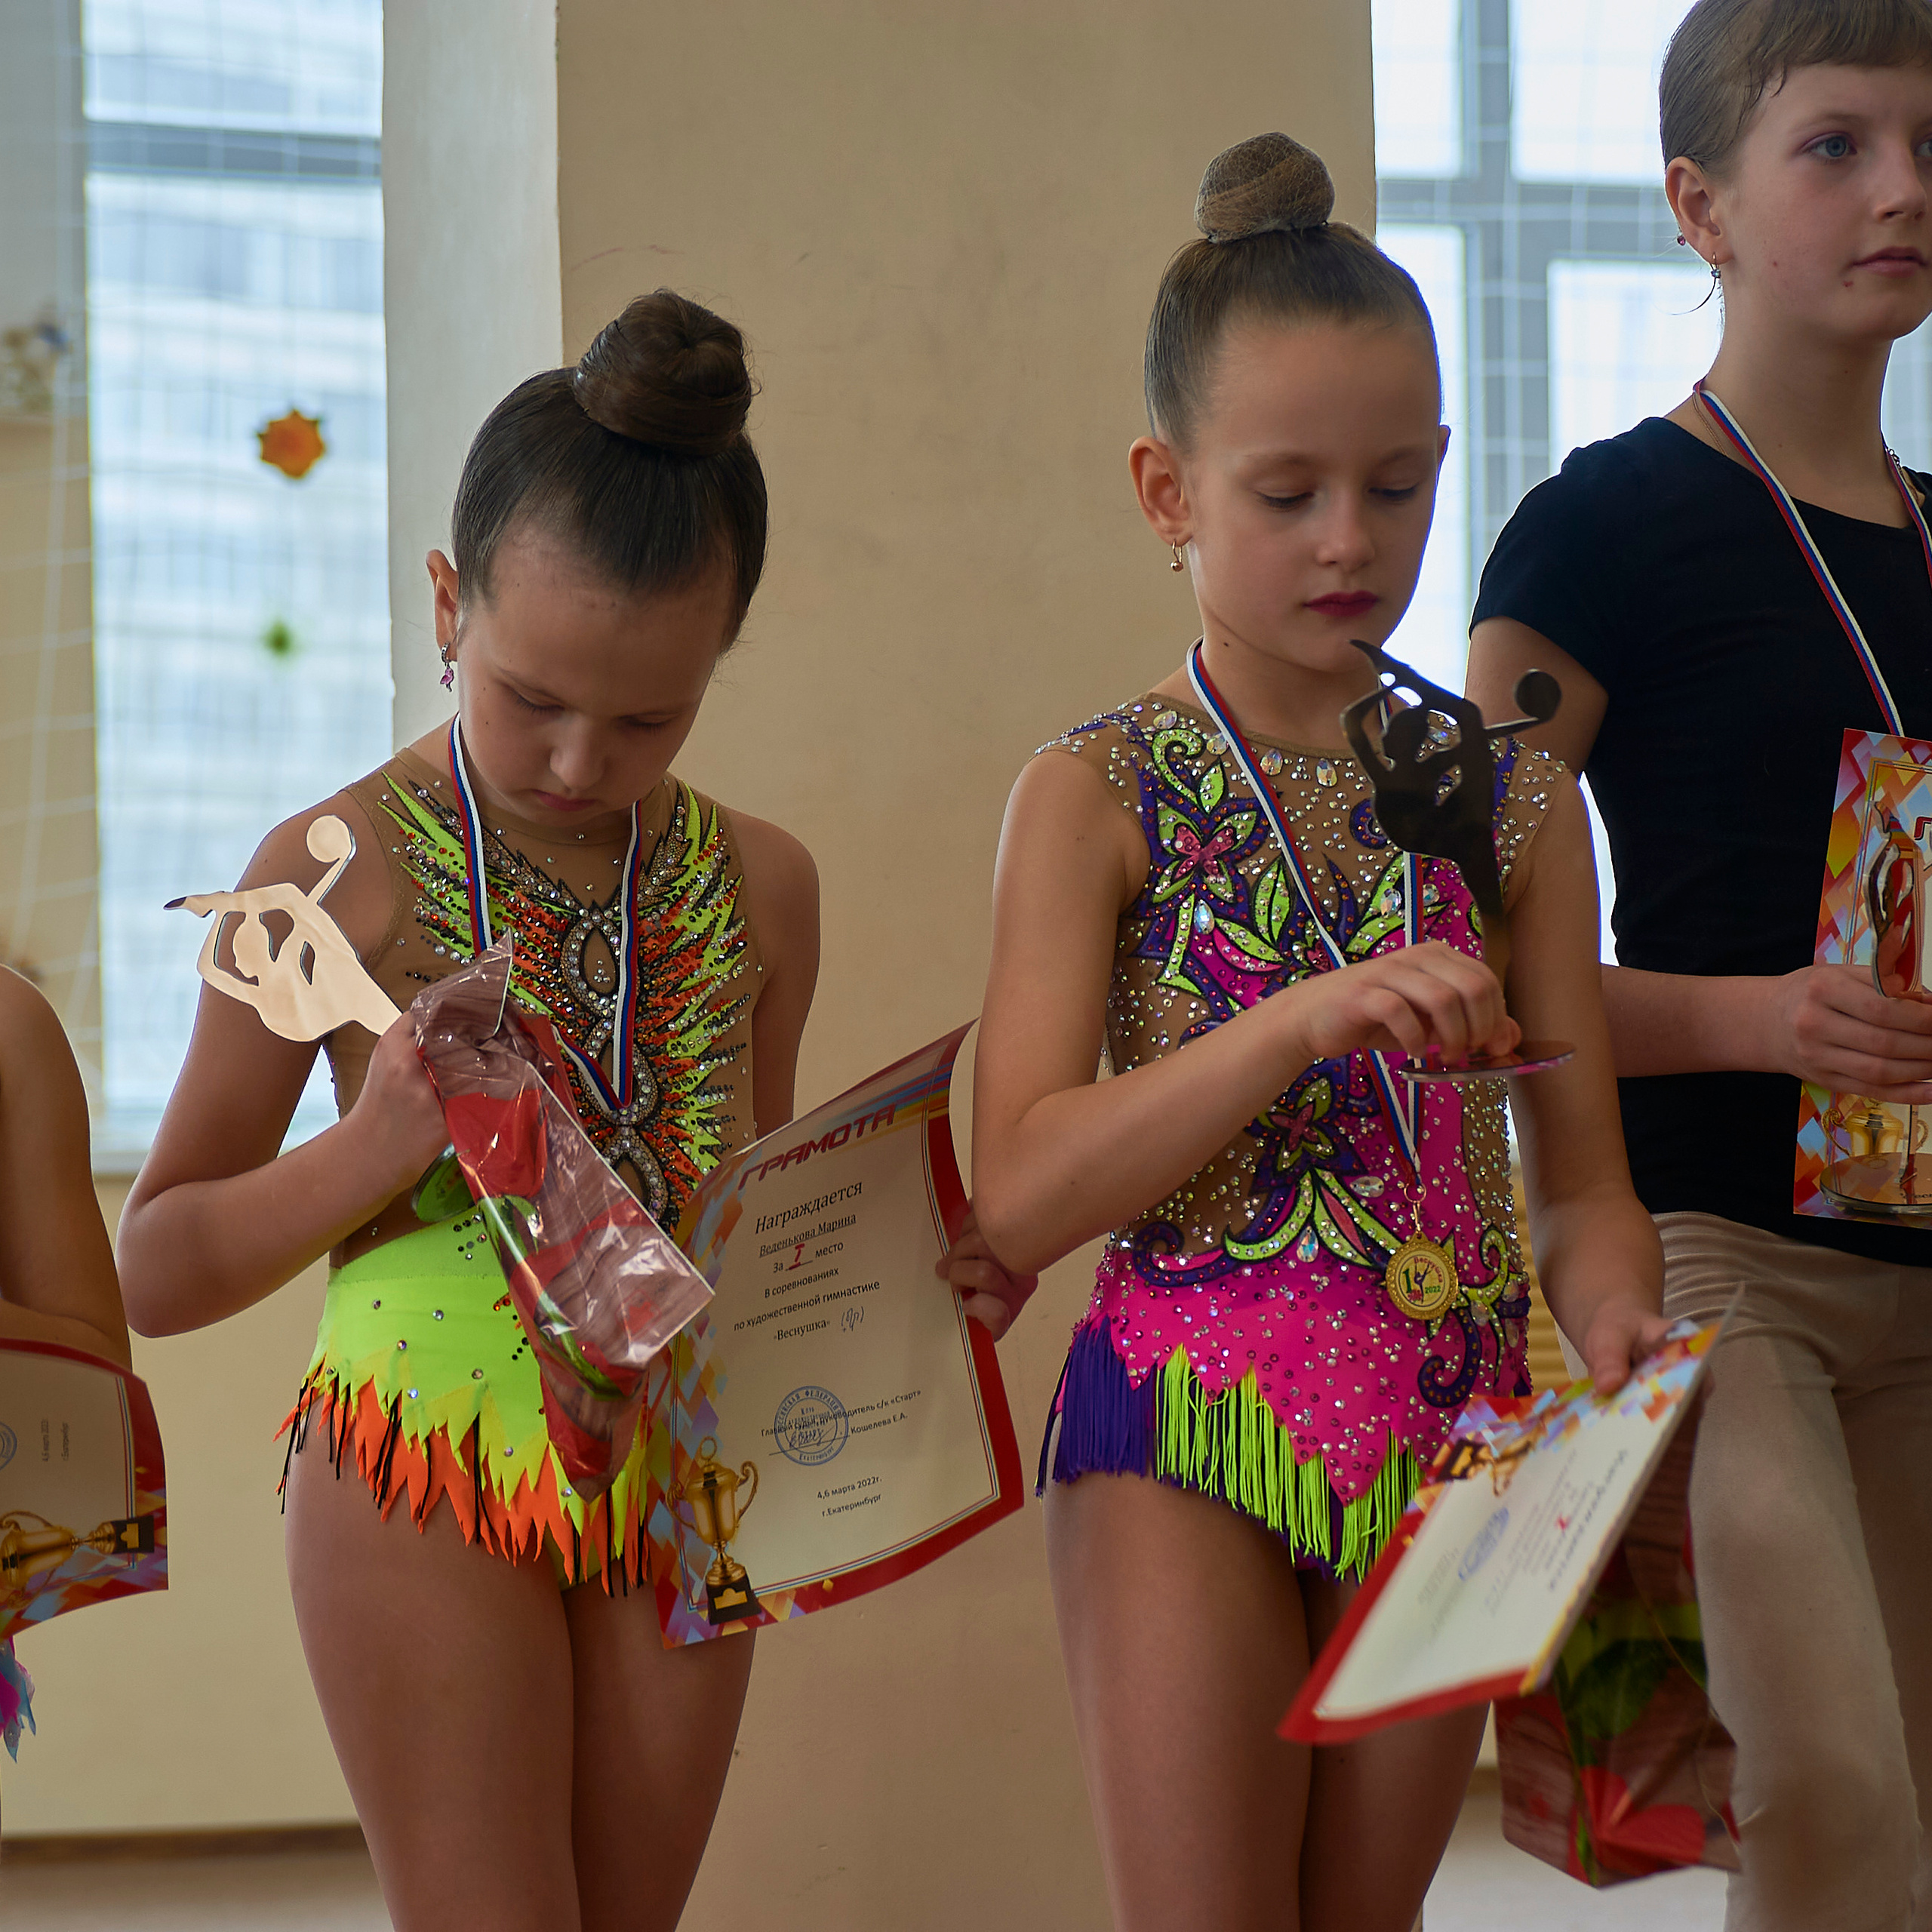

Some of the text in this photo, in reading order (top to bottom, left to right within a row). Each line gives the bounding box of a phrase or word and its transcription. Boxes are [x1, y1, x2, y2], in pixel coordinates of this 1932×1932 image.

[738, 1103, 897, 1191] ГРАМОТА
[755, 1182, 863, 1234] Награждается
[759, 1214, 857, 1258] Веденькова Марина
[773, 1263, 784, 1273] За
[815, 1241, 844, 1258] место
[764, 1268, 839, 1298] В соревнованиях
[1425, 1284, 1441, 1294] 2022
[734, 1281, 881, 1331] по художественной гимнастике
[851, 1412, 909, 1435] Кошелева Е.А.
[817, 1475, 882, 1500] 4,6 марта 2022г.
[822, 1494, 882, 1517] г.Екатеринбург
